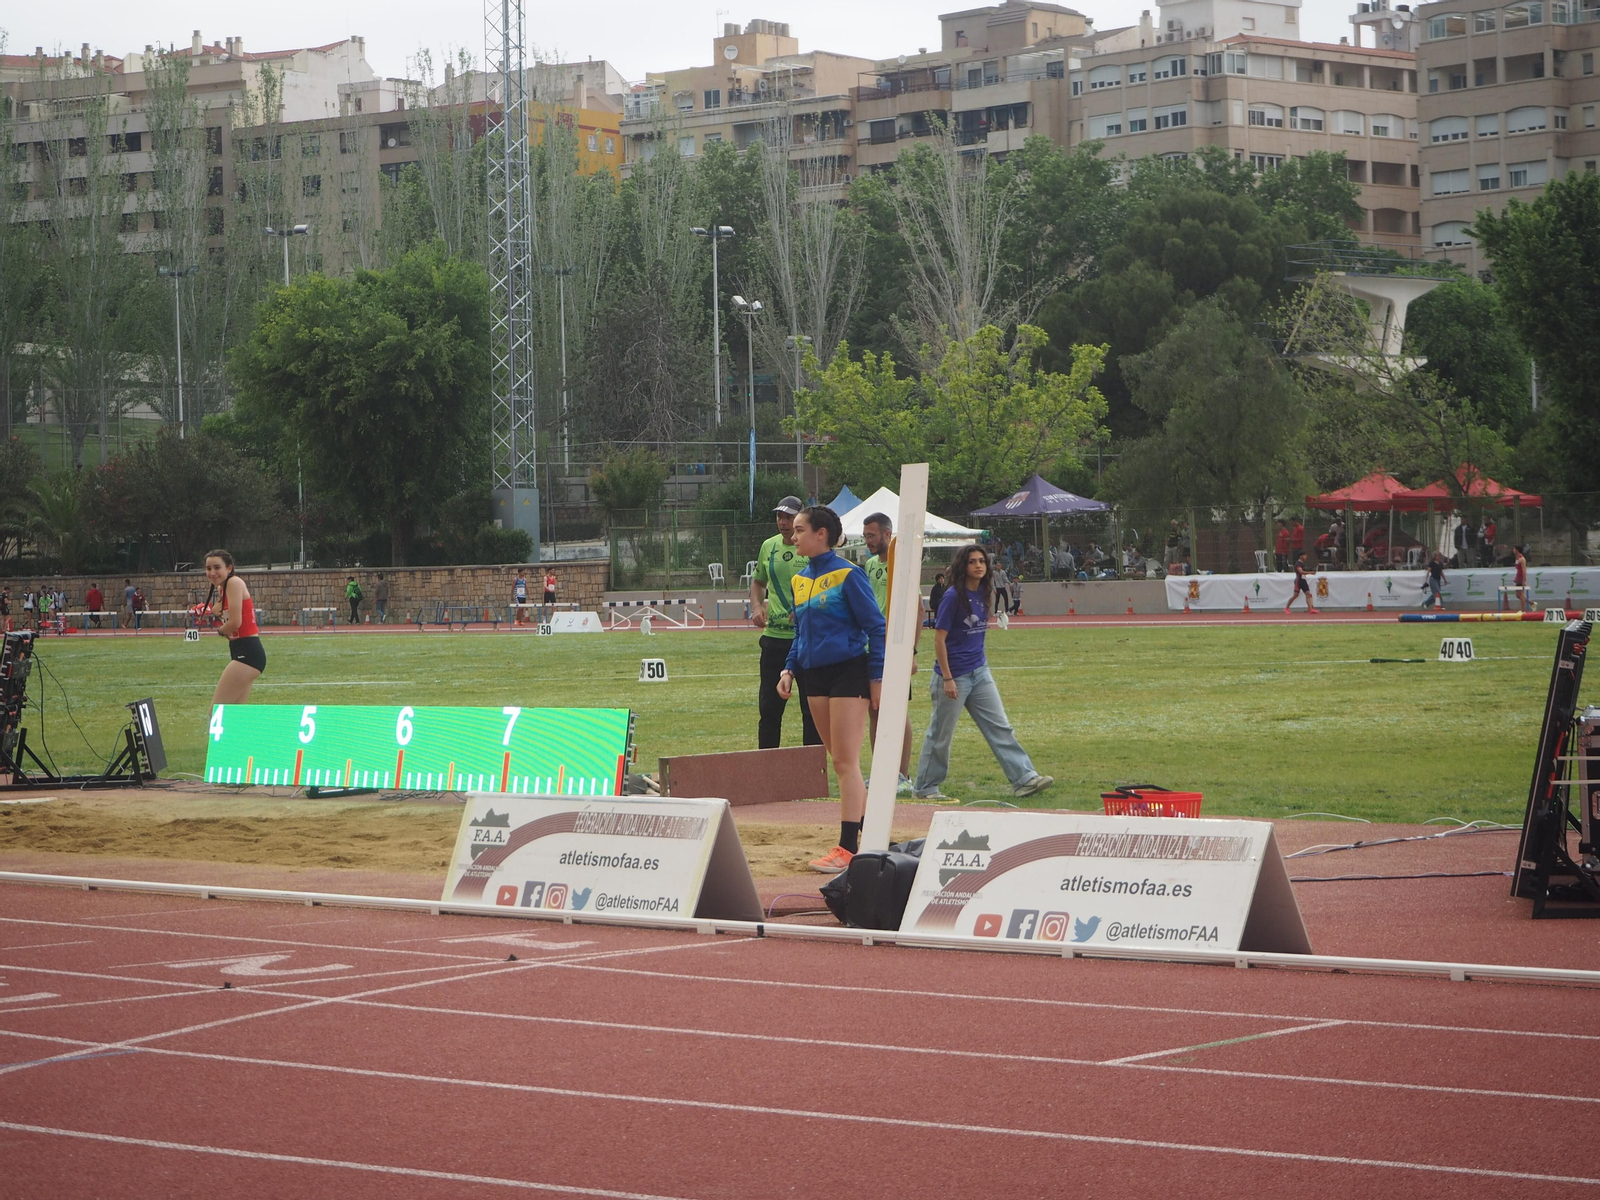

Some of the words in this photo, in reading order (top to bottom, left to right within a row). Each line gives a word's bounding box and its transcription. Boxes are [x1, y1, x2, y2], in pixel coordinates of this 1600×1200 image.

[1586, 610, 1595, 620] 60
[187, 631, 198, 640] 40
[541, 625, 552, 635] 50
[1440, 641, 1454, 658] 40
[1456, 641, 1472, 658] 40
[647, 661, 665, 679] 50
[209, 704, 224, 741] 4
[299, 706, 317, 743] 5
[396, 706, 414, 745] 6
[502, 707, 521, 745] 7
[615, 813, 654, 836] ANDALUZA
[473, 829, 506, 843] F.A.A.
[1131, 834, 1183, 860] ANDALUZA
[559, 850, 660, 870] atletismofaa.es
[942, 852, 985, 867] F.A.A.
[1060, 875, 1192, 897] atletismofaa.es
[595, 893, 679, 911] @atletismoFAA
[1106, 921, 1219, 942] @atletismoFAA
